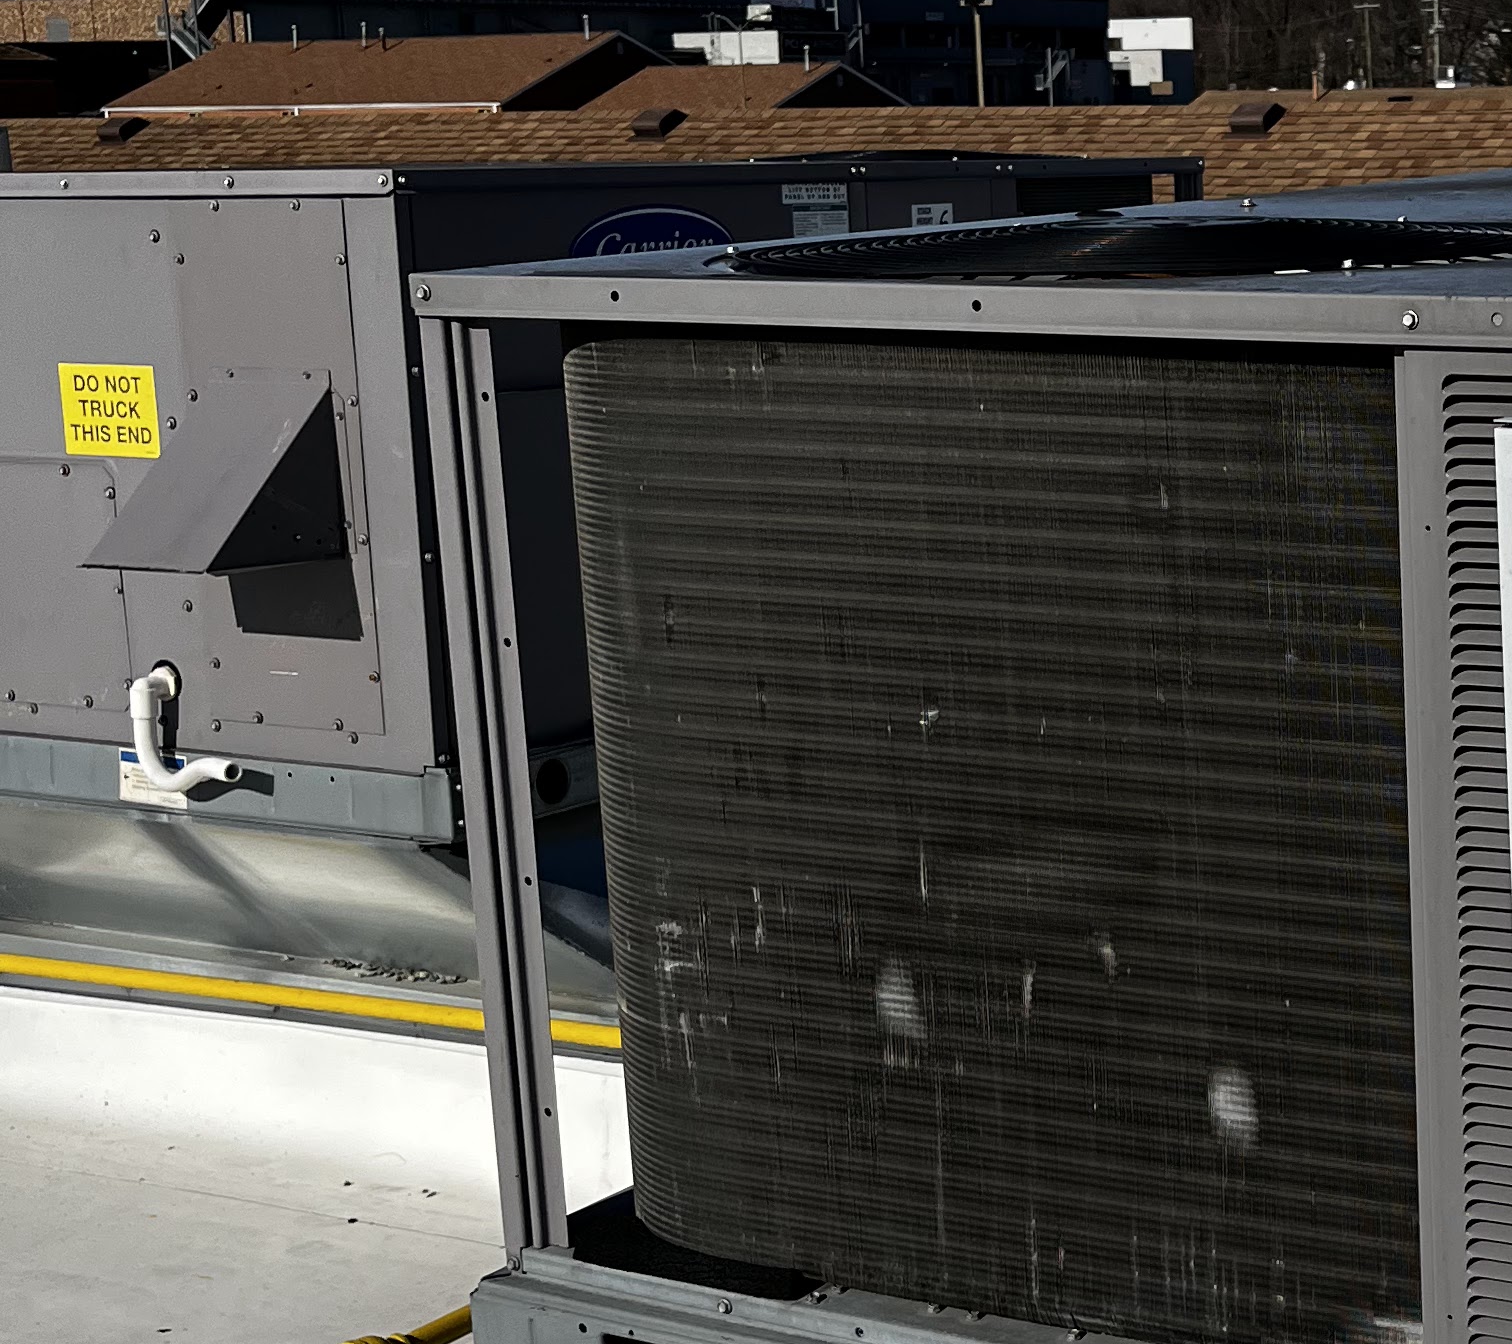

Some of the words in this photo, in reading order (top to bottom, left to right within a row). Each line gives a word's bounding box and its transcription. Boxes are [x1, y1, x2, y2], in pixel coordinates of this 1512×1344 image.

[73, 374, 99, 392] DO
[105, 375, 141, 394] NOT
[78, 399, 141, 419] TRUCK
[70, 423, 111, 443] THIS
[116, 426, 152, 444] END
